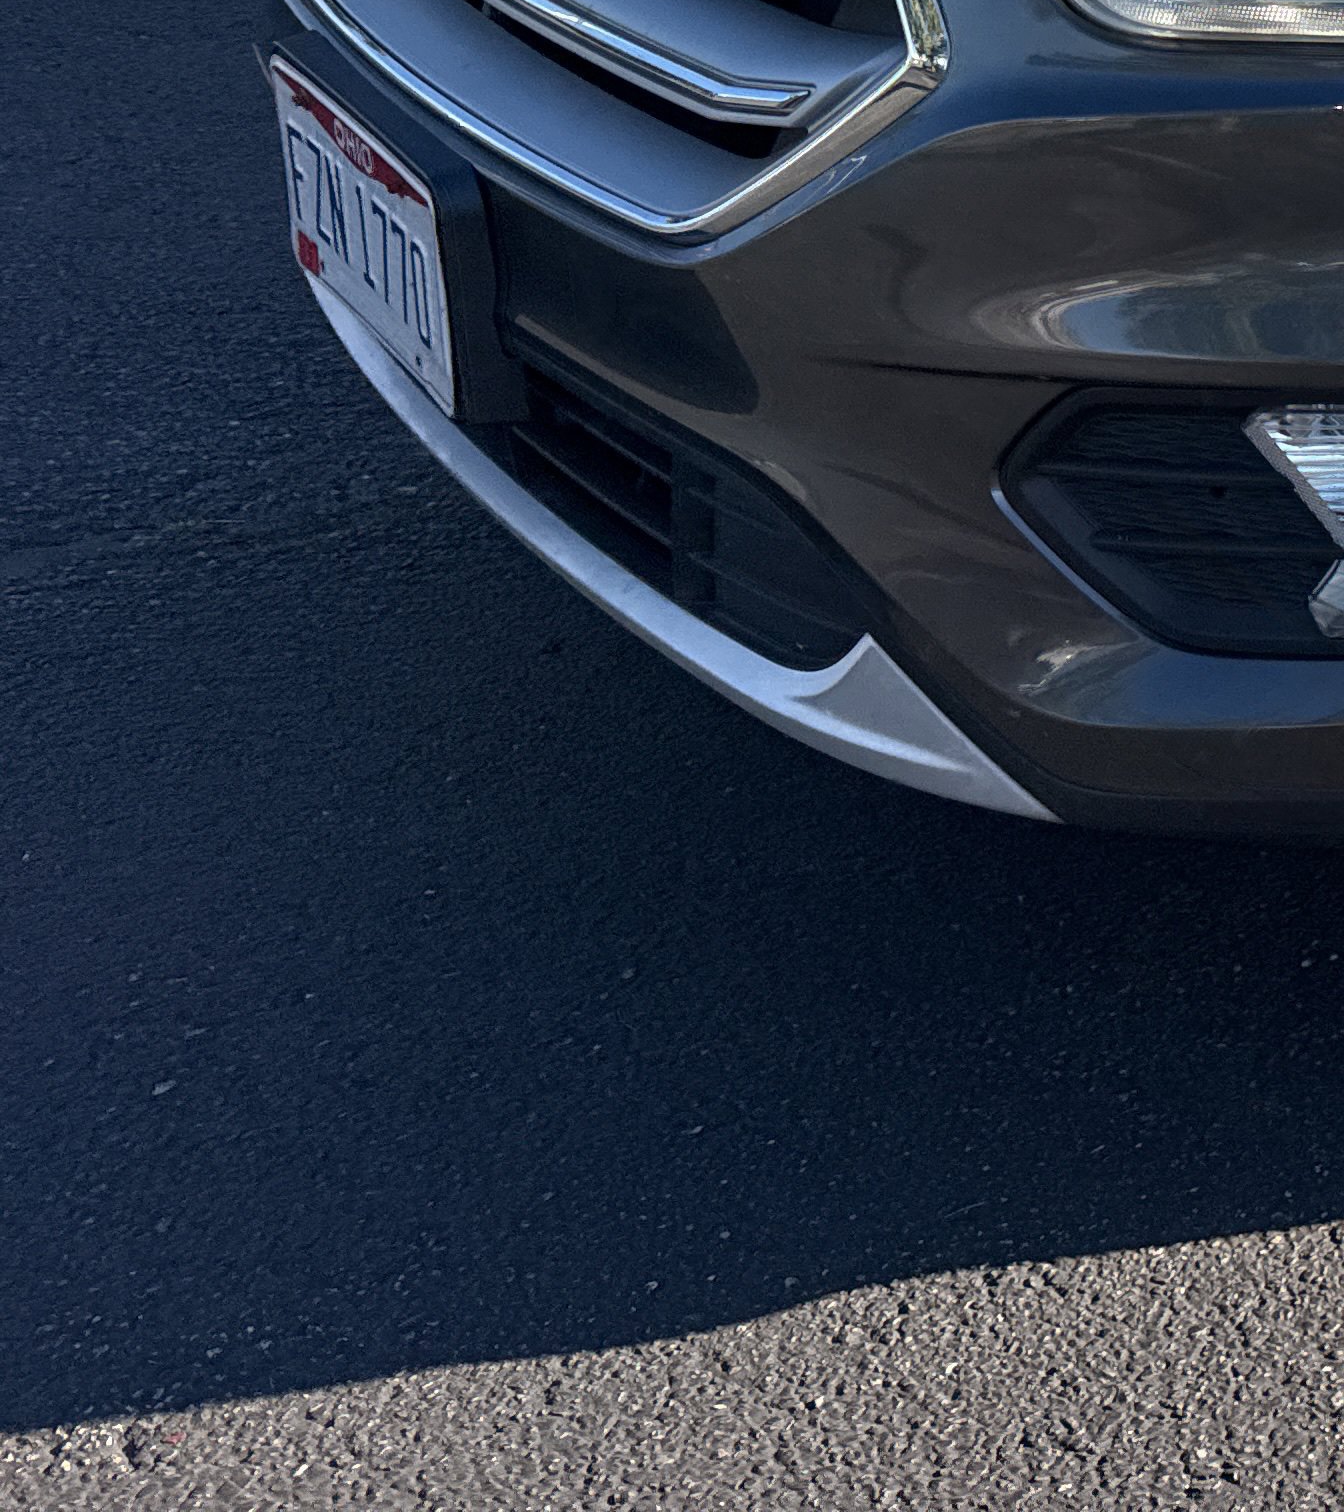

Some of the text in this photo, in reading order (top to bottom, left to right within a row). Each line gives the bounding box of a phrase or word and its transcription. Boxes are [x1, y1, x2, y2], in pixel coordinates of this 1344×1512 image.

[333, 117, 376, 177] OHIO
[286, 119, 433, 351] FZN 1770
